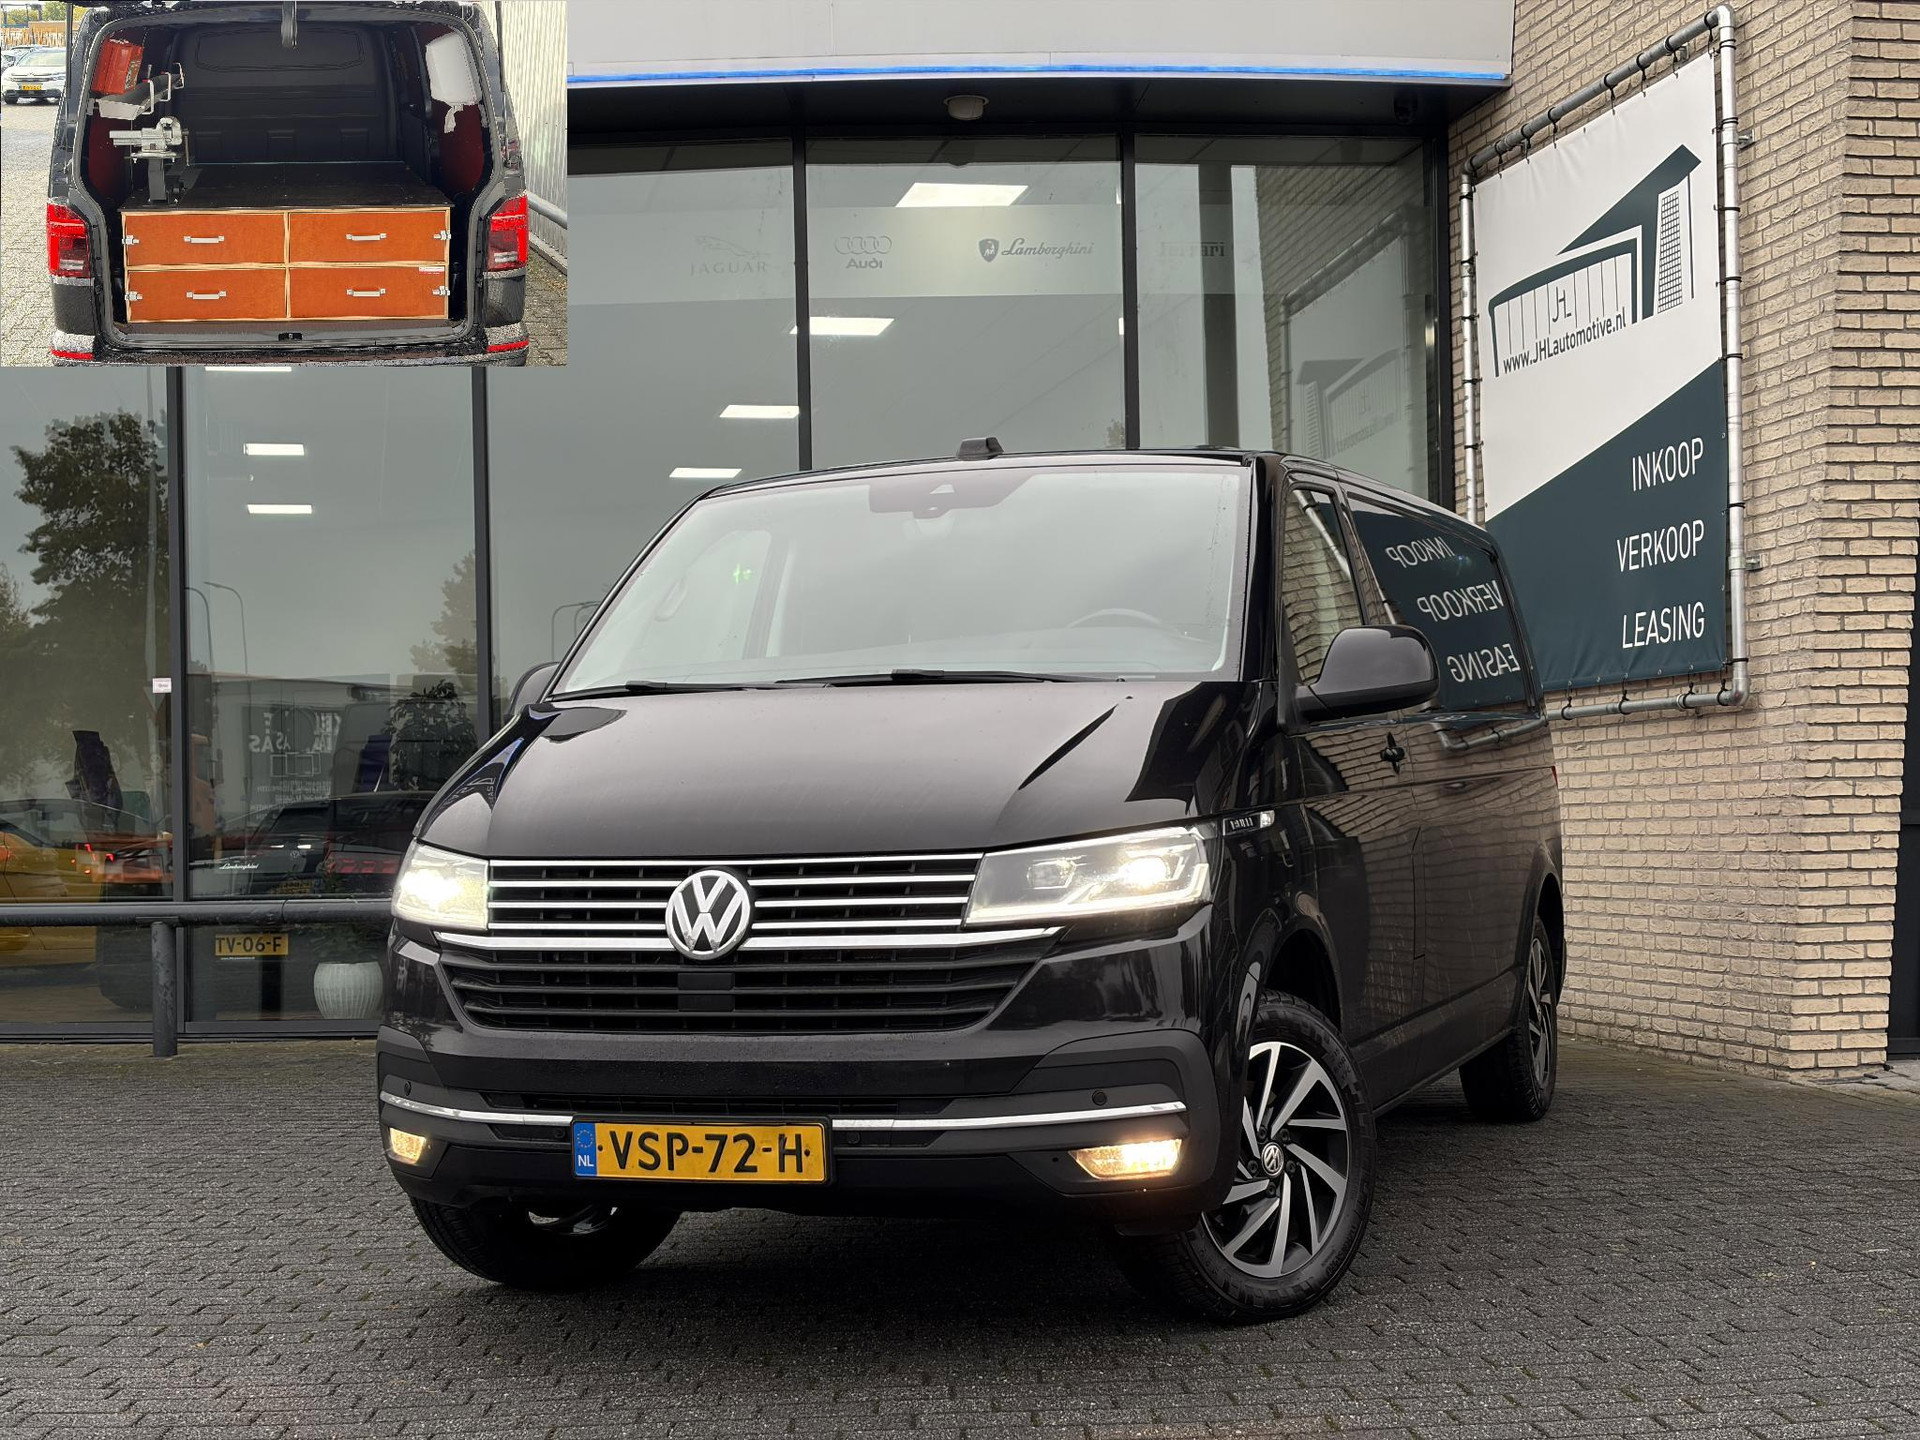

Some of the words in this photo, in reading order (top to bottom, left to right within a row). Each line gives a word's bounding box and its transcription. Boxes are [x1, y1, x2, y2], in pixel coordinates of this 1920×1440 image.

[845, 257, 883, 269] Audi
[1001, 237, 1095, 259] Lamborghini
[690, 261, 768, 276] JAGUAR
[1503, 306, 1626, 374] www.JHLautomotive.nl
[1632, 437, 1704, 492] INKOOP
[1616, 519, 1705, 573] VERKOOP
[1622, 601, 1705, 649] LEASING
[216, 936, 282, 953] TV-06-F
[577, 1154, 595, 1167] NL
[609, 1130, 804, 1174] VSP-72-H
